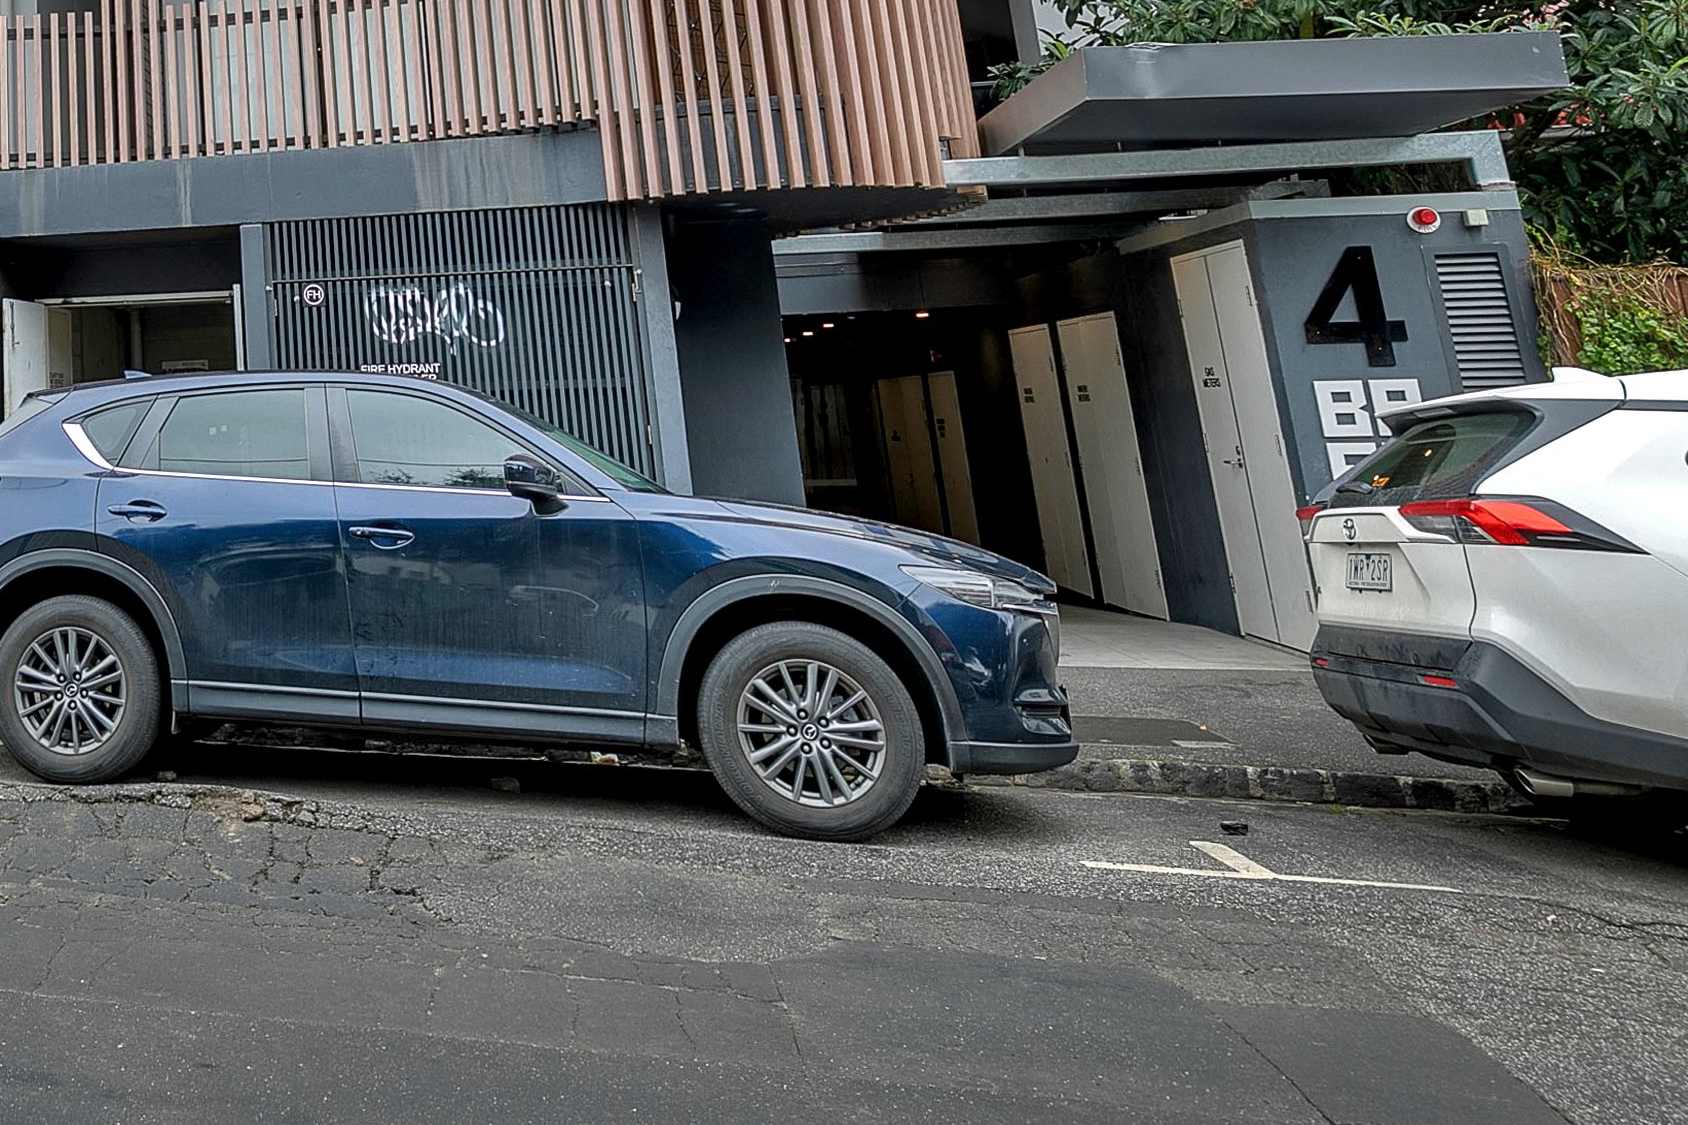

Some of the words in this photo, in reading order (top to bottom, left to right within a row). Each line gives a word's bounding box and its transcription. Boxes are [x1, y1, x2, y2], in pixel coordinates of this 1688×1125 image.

[306, 289, 321, 300] FH
[1304, 245, 1408, 367] 4
[360, 364, 385, 373] FIRE
[387, 363, 441, 374] HYDRANT
